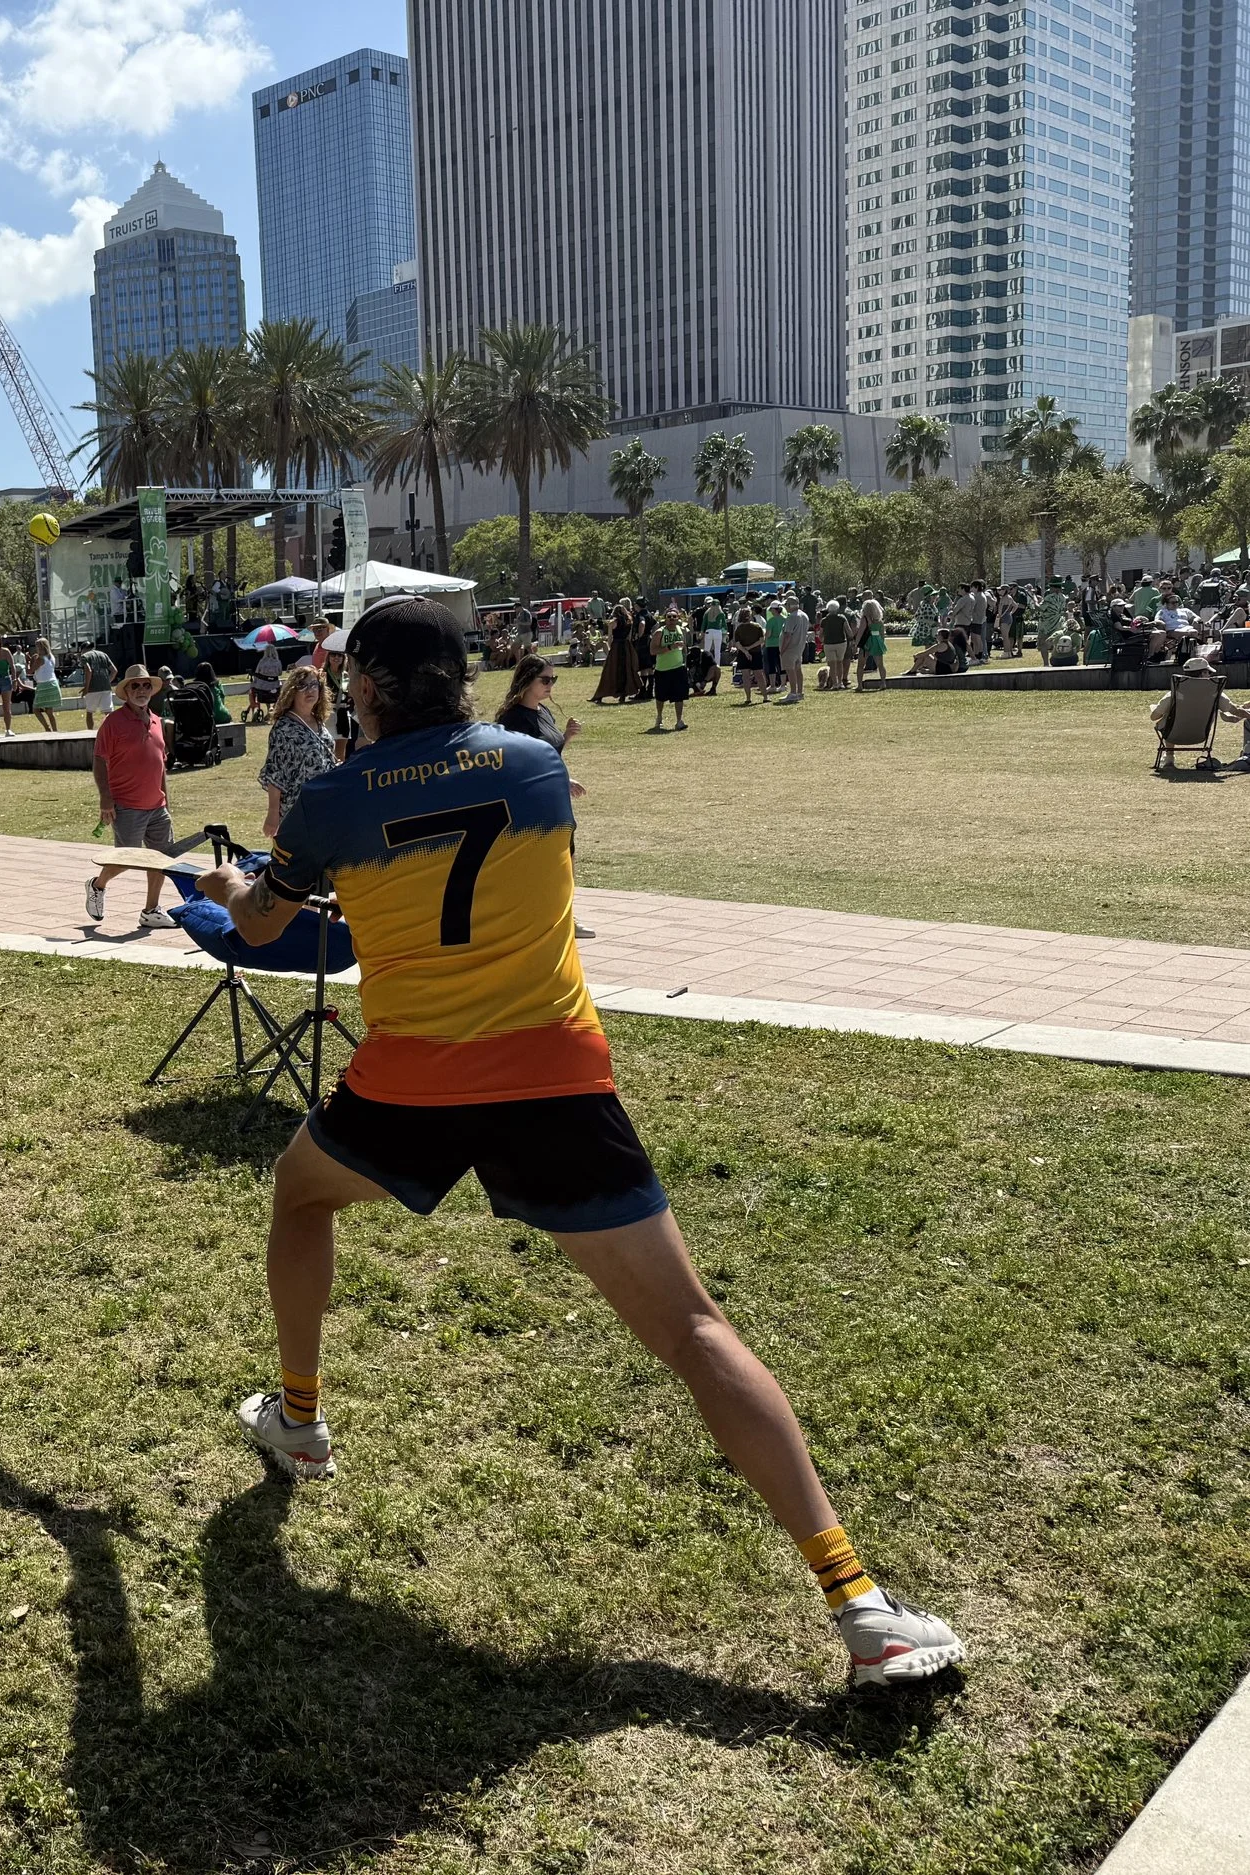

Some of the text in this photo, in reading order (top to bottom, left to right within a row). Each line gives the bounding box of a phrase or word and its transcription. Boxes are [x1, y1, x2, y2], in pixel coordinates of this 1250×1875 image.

[300, 83, 325, 103] PNC
[109, 218, 144, 239] TRUIST
[394, 281, 416, 293] FIFTH
[1180, 340, 1191, 393] HNSON
[89, 551, 114, 561] Tampa's
[361, 747, 504, 792] Tampa Bay
[382, 799, 513, 947] 7
